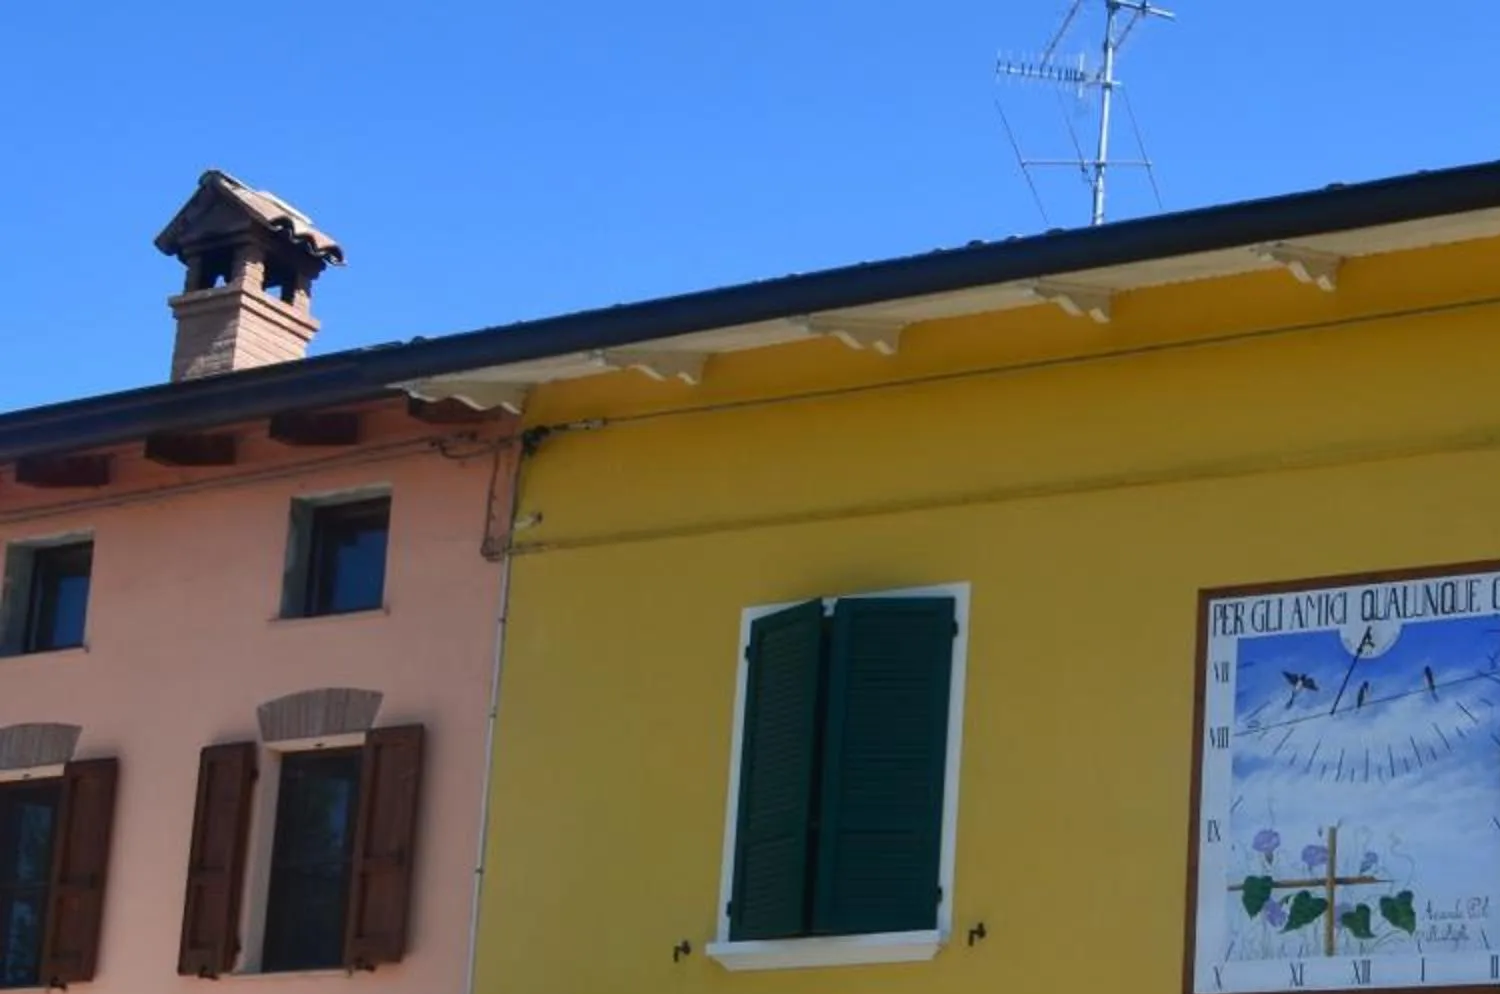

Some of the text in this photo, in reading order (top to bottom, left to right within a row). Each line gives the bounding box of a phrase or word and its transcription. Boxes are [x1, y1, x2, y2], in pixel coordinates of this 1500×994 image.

[1213, 602, 1245, 637] PER
[1251, 597, 1283, 632] GLI
[1289, 592, 1348, 630] AMICI
[1361, 578, 1481, 621] QUALUNQUE
